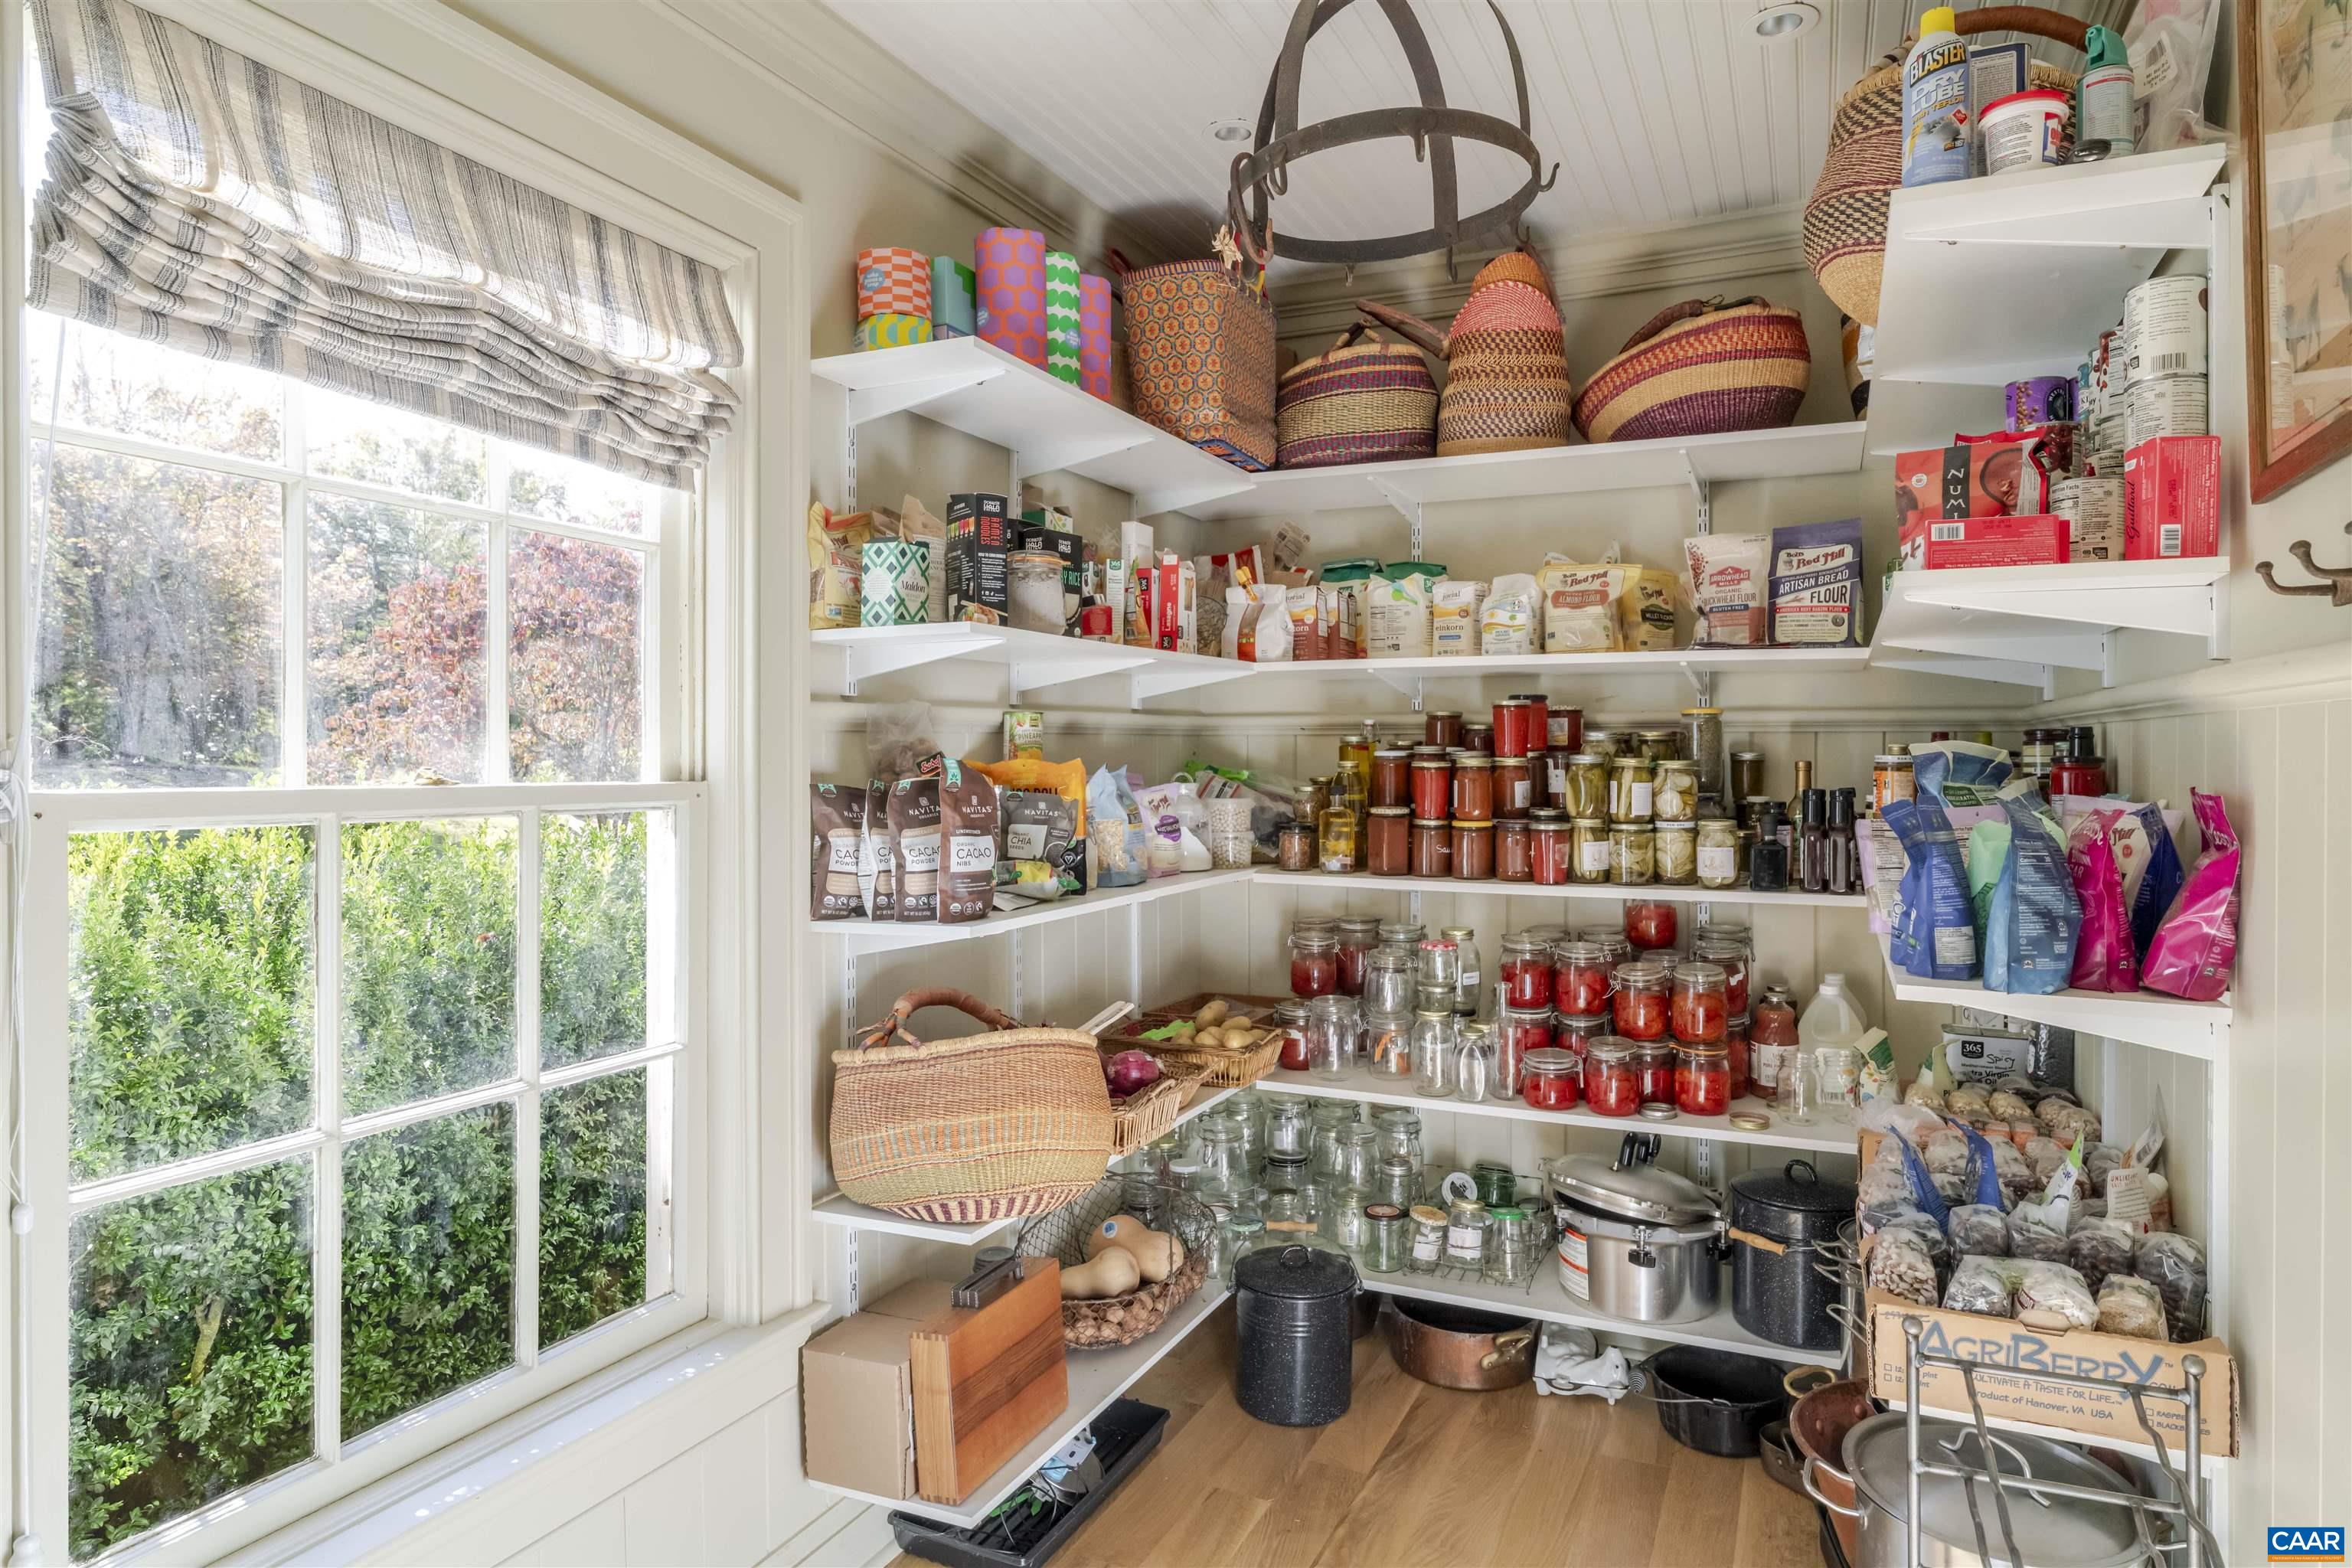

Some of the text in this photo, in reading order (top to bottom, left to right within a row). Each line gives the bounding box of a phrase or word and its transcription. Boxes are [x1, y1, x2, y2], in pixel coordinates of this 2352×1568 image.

[1913, 69, 1965, 103] DRY
[1912, 82, 1965, 117] LUBE
[1946, 468, 1965, 520] NUMI
[981, 516, 990, 544] NOODLES
[991, 518, 1000, 545] RAMEN
[1795, 554, 1820, 570] Red
[1821, 547, 1846, 567] Mill
[1068, 572, 1081, 586] RICE
[1570, 575, 1589, 587] Red
[1589, 570, 1608, 584] Mill
[1710, 571, 1749, 582] ARROWHEAD
[1779, 569, 1849, 596] ARTISAN BREAD
[900, 580, 926, 593] Maldon
[1810, 584, 1847, 604] FLOUR
[1442, 590, 1460, 600] jovial
[1559, 593, 1601, 604] ALMOND FLOUR
[1702, 593, 1757, 607] BUCKWHEAT FLOUR
[1436, 623, 1464, 632] einkorn
[909, 806, 941, 815] NAVITA
[1011, 837, 1031, 846] CHIA
[2112, 827, 2137, 845] Mill
[956, 848, 991, 859] CACAO
[1963, 1044, 1981, 1053] 365
[1986, 1054, 2016, 1069] Spicy
[1984, 1070, 2010, 1080] Virgin
[2024, 1380, 2032, 1389] A
[2033, 1381, 2064, 1396] TASTE
[2067, 1387, 2086, 1400] FOR
[2072, 1405, 2085, 1416] VA
[2091, 1408, 2114, 1420] USA
